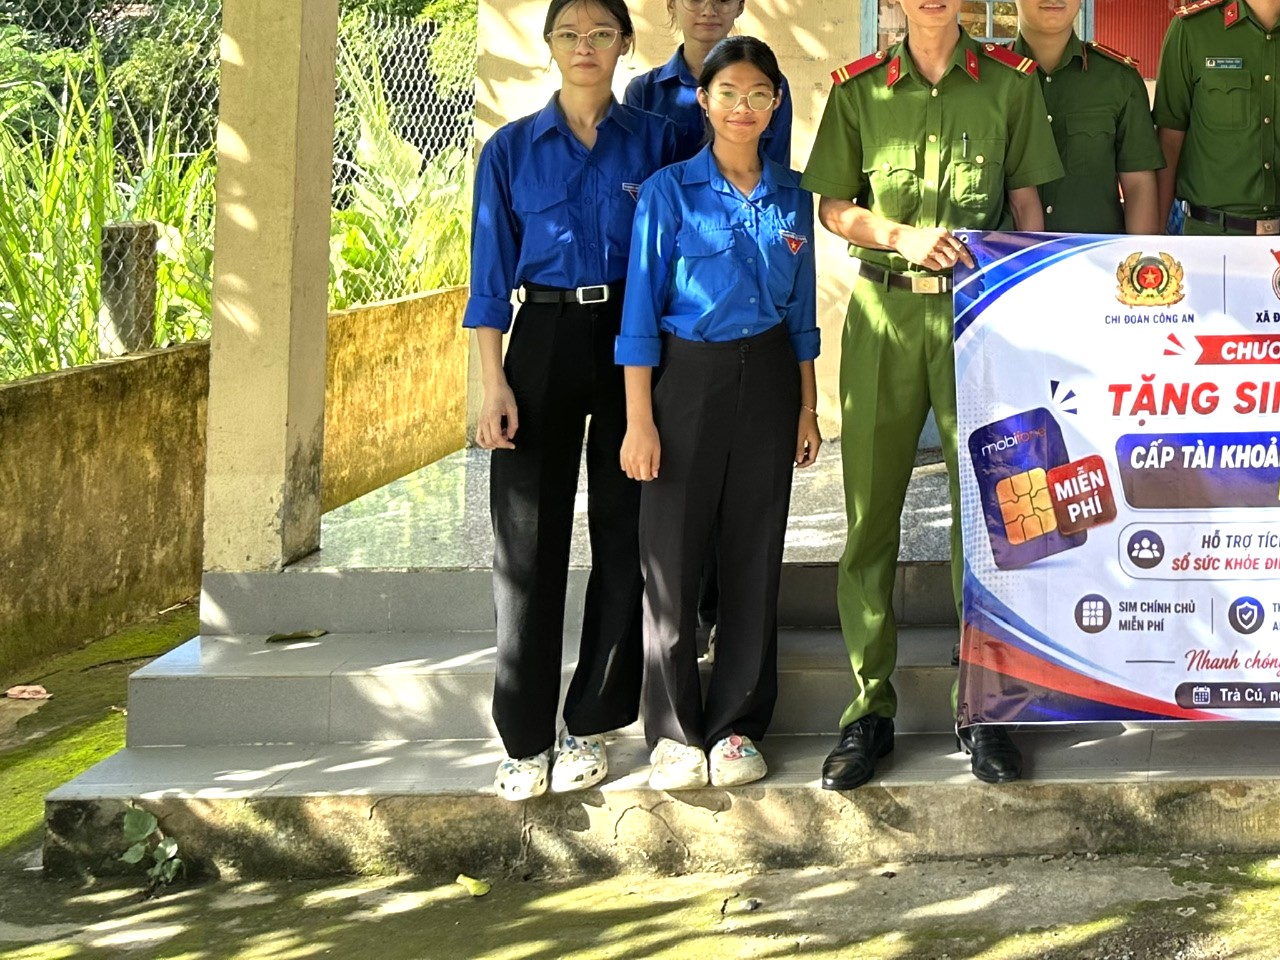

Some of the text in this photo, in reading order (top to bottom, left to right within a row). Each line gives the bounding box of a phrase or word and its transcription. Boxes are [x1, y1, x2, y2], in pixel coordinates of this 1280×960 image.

[1105, 313, 1194, 324] CHI ĐOÀN CÔNG AN
[1256, 310, 1270, 323] XÃ
[1108, 373, 1220, 426] TẶNG
[981, 427, 1047, 456] mobifone
[1130, 439, 1175, 469] CẤP
[1181, 439, 1215, 468] TÀI
[1054, 466, 1105, 502] MIỄN
[1067, 494, 1103, 523] PHÍ
[1201, 529, 1221, 548] HỖ
[1226, 534, 1253, 551] TRỢ
[1172, 552, 1190, 571] SỔ
[1193, 555, 1220, 571] SỨC
[1118, 600, 1195, 614] SIM CHÍNH CHỦ
[1118, 616, 1164, 631] MIỄN PHÍ
[1185, 649, 1240, 672] Nhanh
[1220, 688, 1241, 701] Trà
[1244, 685, 1266, 703] Cú,
